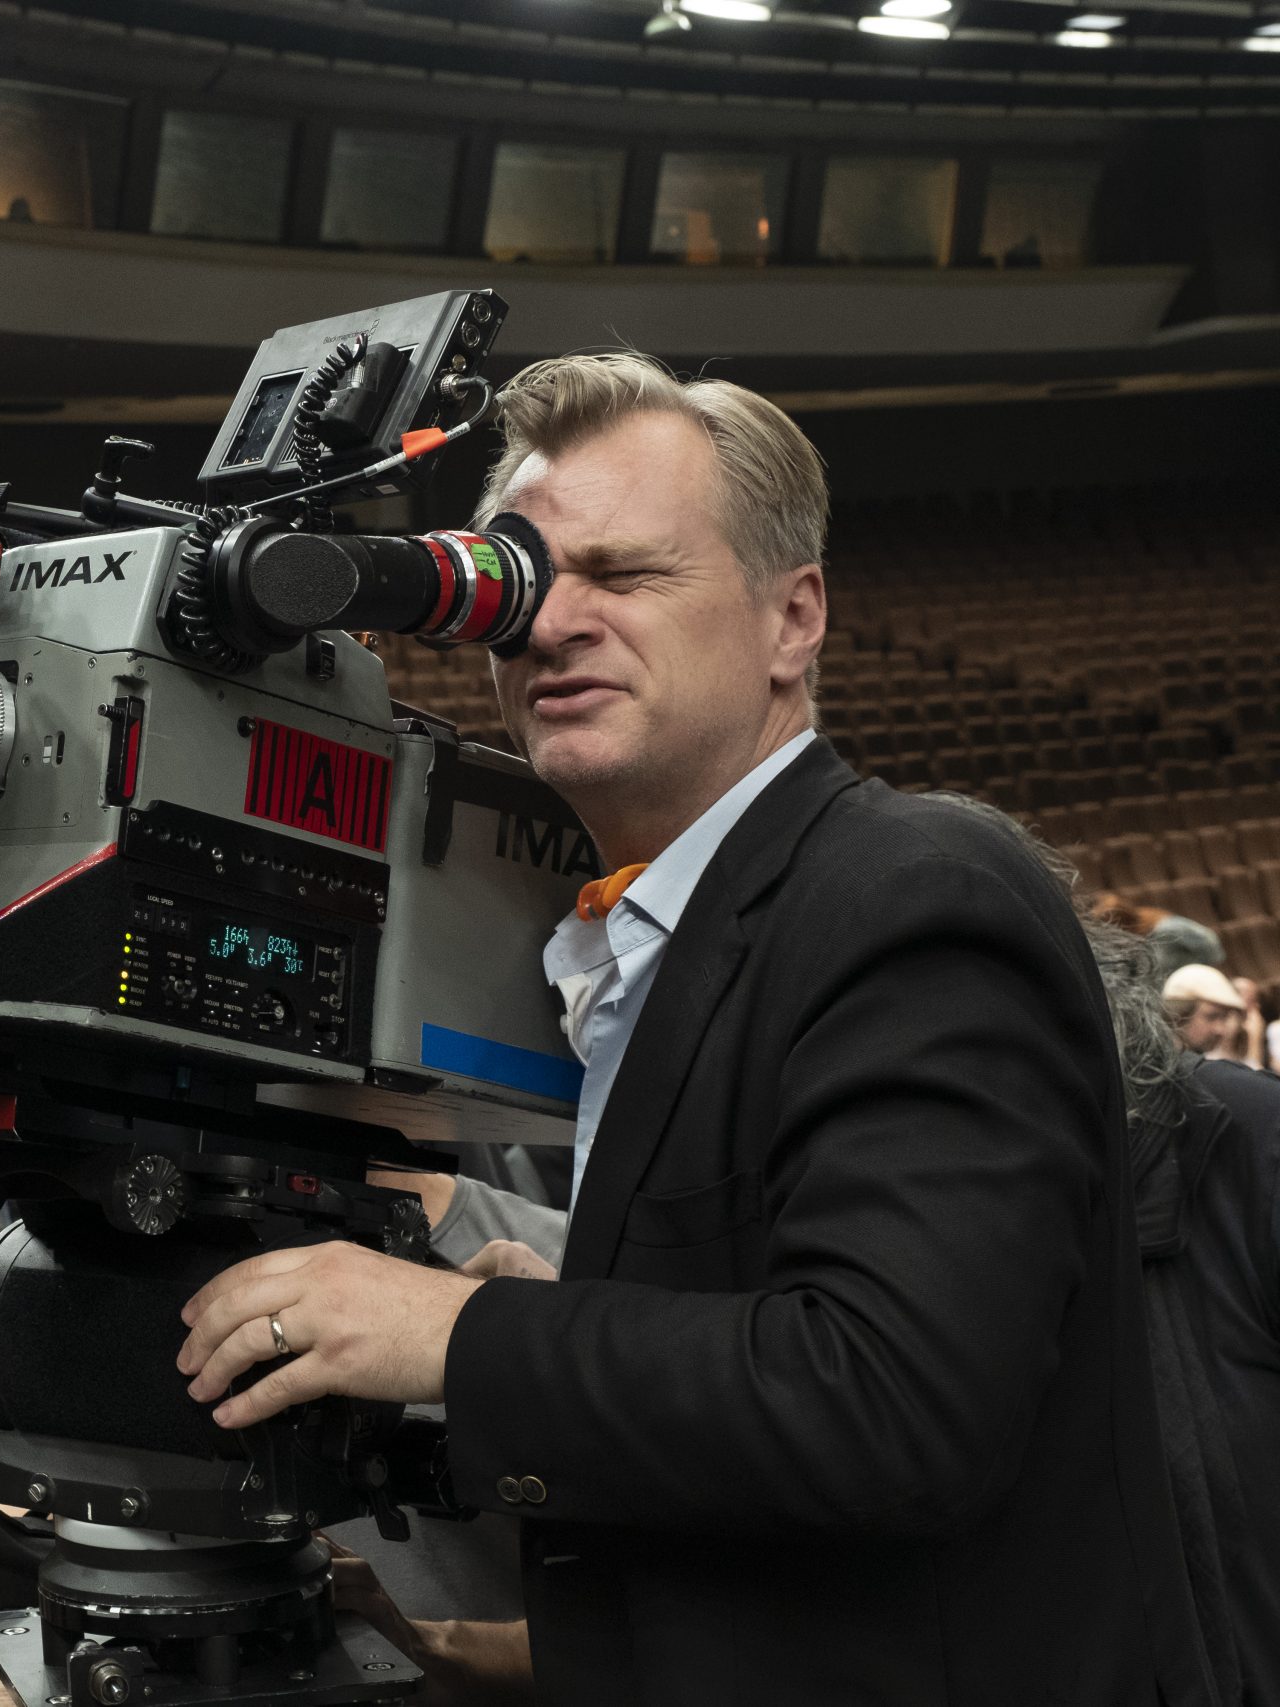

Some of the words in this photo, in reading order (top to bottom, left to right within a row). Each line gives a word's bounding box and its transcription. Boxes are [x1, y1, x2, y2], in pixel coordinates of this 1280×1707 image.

[10, 551, 133, 592] IMAX
[298, 752, 337, 828] A
[495, 810, 607, 881] IMA
[147, 894, 160, 903] LOCAL
[161, 898, 174, 906] SPEED
[331, 1015, 345, 1024] STOP
